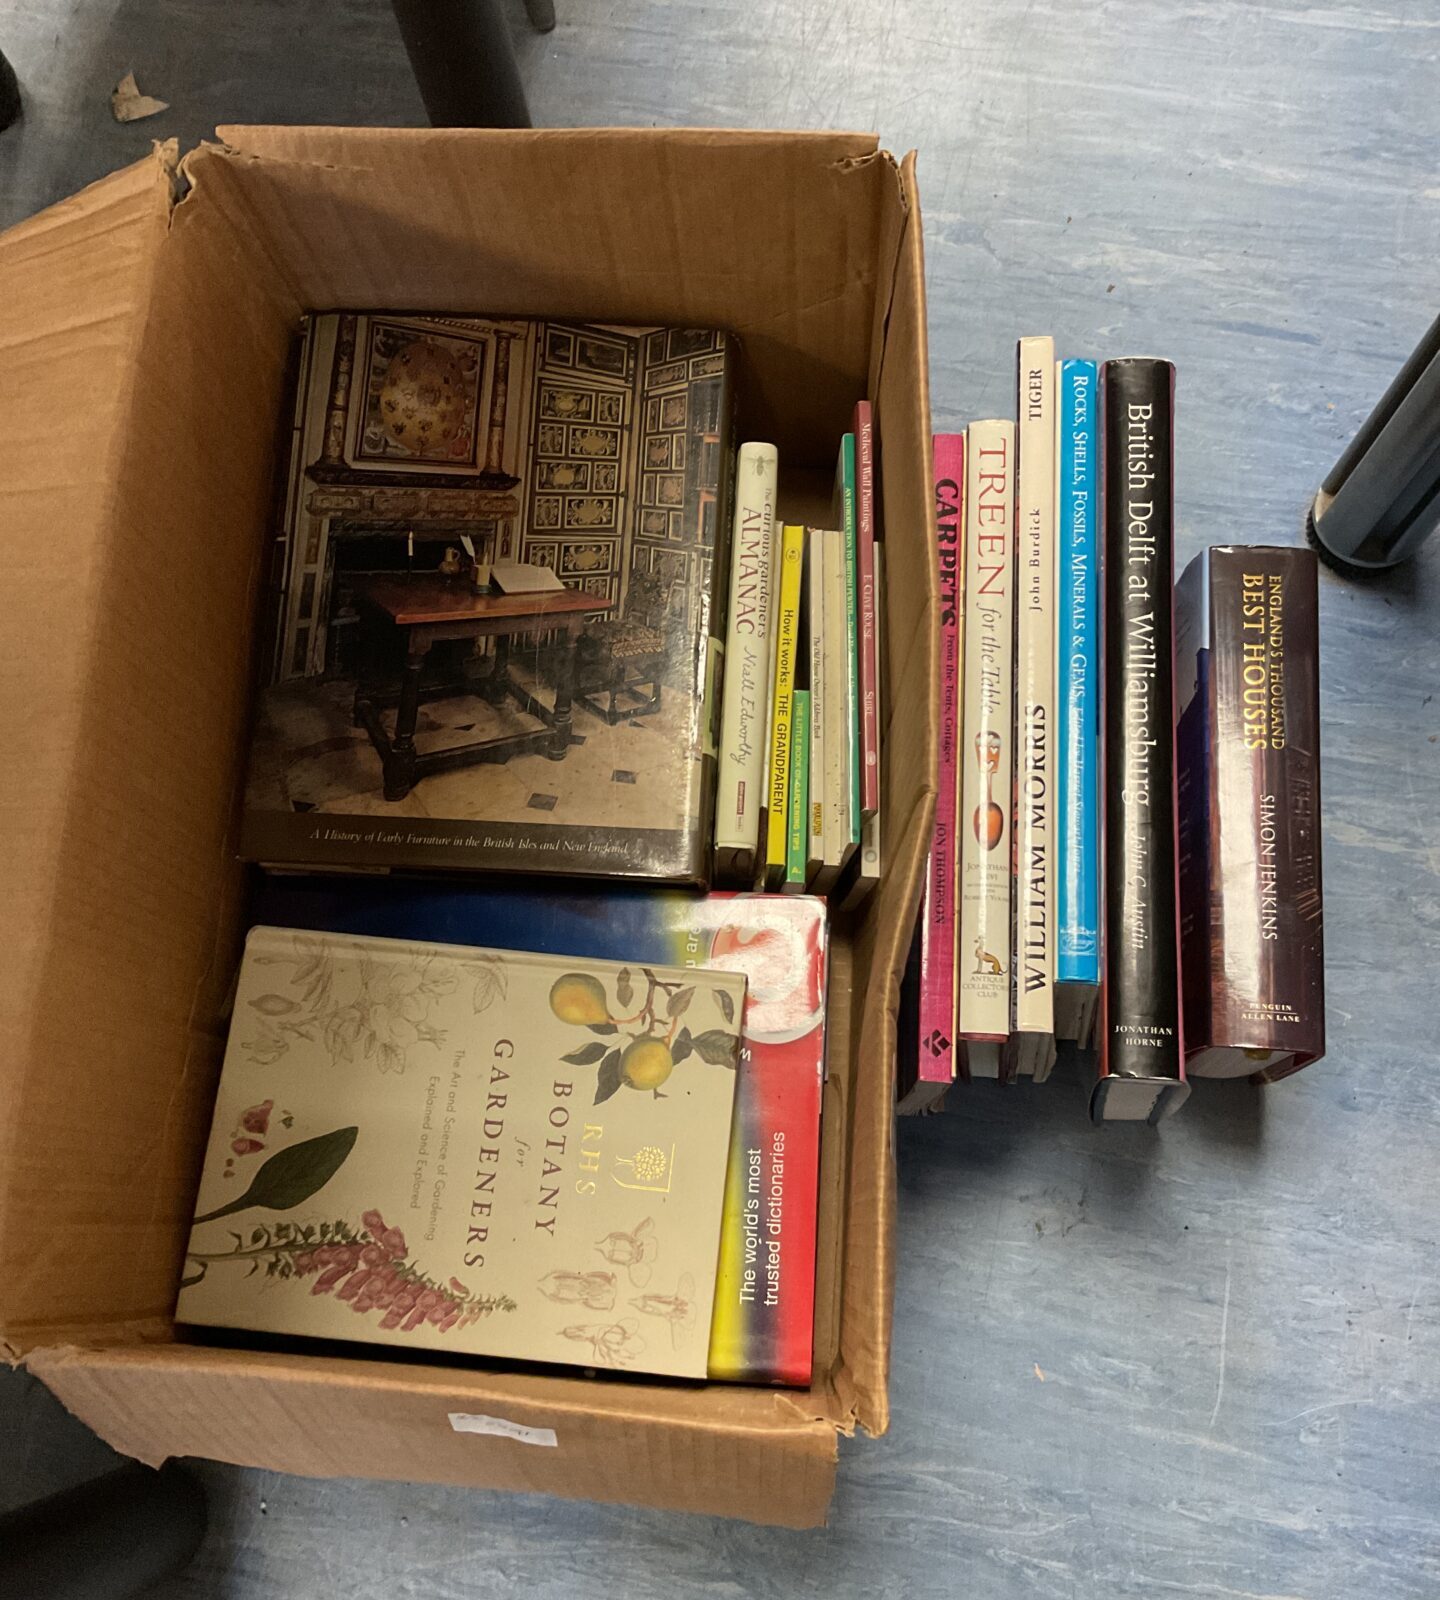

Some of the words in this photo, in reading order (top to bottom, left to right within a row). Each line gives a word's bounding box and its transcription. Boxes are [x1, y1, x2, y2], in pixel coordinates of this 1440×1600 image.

[1028, 369, 1043, 421] TIGER
[861, 423, 872, 464] Medieval
[1127, 402, 1155, 490] British
[862, 467, 872, 486] Wall
[761, 503, 772, 557] curious
[861, 490, 872, 533] Paintings
[977, 437, 1006, 597] TREEN
[1127, 500, 1155, 565] Delft
[1028, 508, 1041, 568] Burdick
[736, 507, 762, 635] ALMANAC
[1028, 576, 1043, 611] John
[1071, 553, 1088, 630] MINERALS
[1128, 575, 1151, 601] at
[782, 609, 794, 635] How
[976, 602, 1002, 631] for
[1242, 573, 1265, 634] BEST
[1268, 575, 1283, 658] ENGLAND'S
[782, 638, 793, 646] it
[946, 635, 956, 662] From
[981, 634, 1001, 664] the
[1072, 635, 1086, 648] &
[741, 646, 757, 694] Niall
[779, 649, 789, 687] works:
[945, 664, 955, 681] the
[980, 666, 1001, 714] Table
[777, 694, 789, 716] THE
[796, 702, 804, 716] THE
[1122, 611, 1157, 806] Williamsburg
[1243, 643, 1267, 750] HOUSES
[1269, 662, 1285, 750] THOUSAND
[729, 695, 755, 766] Edworthy
[795, 718, 803, 743] LITTLE
[772, 723, 788, 815] GRANDPARENT
[1024, 705, 1046, 831] MORRIS
[310, 829, 319, 839] A
[324, 829, 361, 844] History
[364, 831, 375, 844] of
[377, 832, 403, 845] Early
[406, 833, 451, 846] Furniture
[453, 837, 463, 846] in
[465, 836, 479, 847] the
[483, 836, 515, 848] British
[518, 838, 538, 849] Isles
[540, 840, 560, 851] and
[562, 840, 586, 851] New
[588, 841, 629, 854] England
[792, 832, 801, 851] TIPS
[936, 822, 946, 847] JON
[1260, 794, 1276, 857] SIMON
[935, 852, 946, 924] THOMPSON
[1259, 864, 1278, 940] JENKINS
[1024, 845, 1046, 994] WILLIAM
[1131, 898, 1148, 949] Austin
[970, 975, 1004, 983] ANTIQUE
[1114, 1024, 1173, 1036] JONATHAN
[1241, 1012, 1273, 1021] ALLEN
[1276, 1013, 1300, 1023] LANE
[1250, 1002, 1292, 1012] PENGUIN
[450, 1049, 465, 1068] The
[1125, 1037, 1163, 1048] HORNE
[425, 1075, 440, 1131] Explained
[448, 1091, 459, 1112] and
[449, 1071, 461, 1089] Art
[418, 1134, 429, 1157] and
[438, 1116, 456, 1161] Science
[463, 1038, 514, 1268] GARDENERS
[514, 1136, 531, 1167] for
[534, 1080, 573, 1237] BOTANY
[575, 1122, 603, 1195] RHS
[410, 1159, 428, 1210] Explored
[437, 1162, 448, 1177] of
[747, 1148, 762, 1194] most
[766, 1131, 785, 1236] dictionaries
[423, 1179, 446, 1242] Gardening
[743, 1198, 759, 1264] world's
[739, 1269, 756, 1305] The
[763, 1241, 781, 1307] trusted
